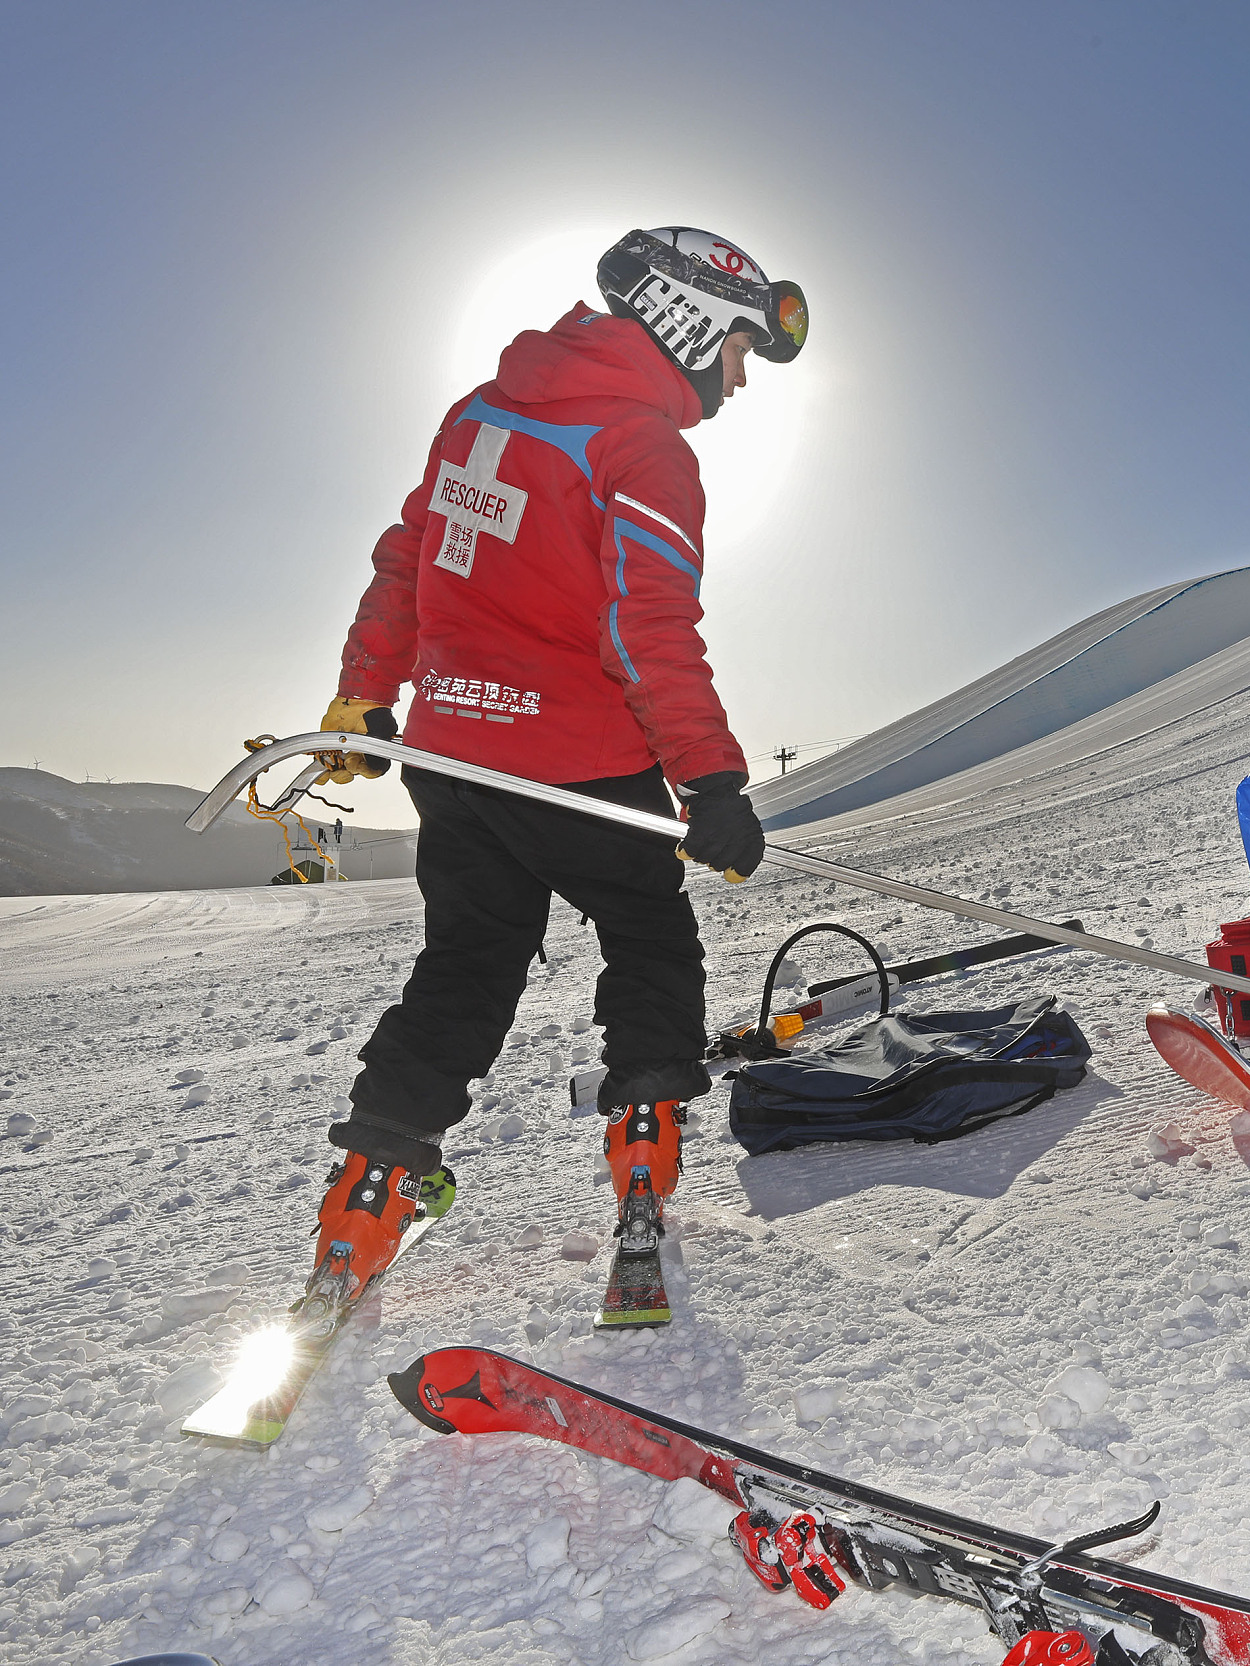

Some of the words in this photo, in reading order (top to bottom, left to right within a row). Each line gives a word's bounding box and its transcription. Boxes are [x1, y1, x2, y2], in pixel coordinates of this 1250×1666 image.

[716, 281, 747, 294] SNOWBOARD
[440, 477, 507, 523] RESCUER
[449, 521, 473, 547] 雪场
[443, 541, 471, 568] 救援
[433, 692, 456, 703] GENTING
[455, 696, 480, 707] RESORT
[481, 700, 509, 712] SECRET
[508, 704, 540, 715] GARDEN
[854, 986, 873, 998] ATOMIC
